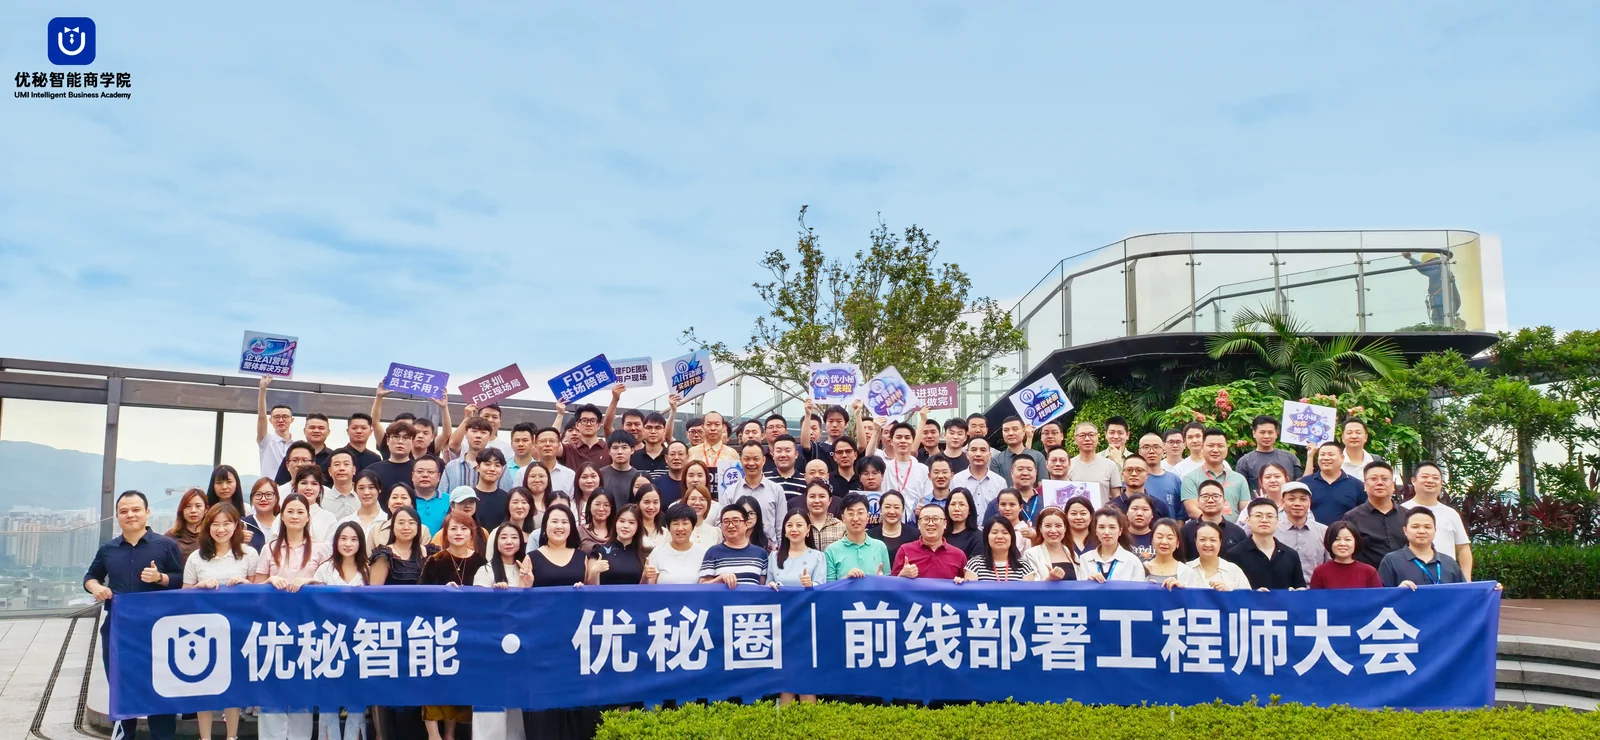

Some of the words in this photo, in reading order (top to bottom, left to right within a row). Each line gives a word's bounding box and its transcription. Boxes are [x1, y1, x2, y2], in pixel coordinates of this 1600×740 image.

[245, 353, 290, 366] 企业AI营销
[243, 361, 290, 375] 整体解决方案
[392, 367, 435, 383] 您钱花了
[563, 364, 595, 387] FDE
[389, 377, 440, 394] 员工不用？
[479, 374, 505, 392] 深圳
[561, 371, 609, 401] 驻场陪跑
[613, 373, 647, 384] 用户现场
[472, 378, 521, 404] FDE现场局
[833, 383, 852, 393] 来啦
[912, 386, 948, 399] 进现场
[726, 471, 738, 480] 今天
[241, 616, 460, 682] 优秘智能
[571, 604, 783, 675] 优秘圈
[842, 601, 1420, 676] 前线部署工程师大会
